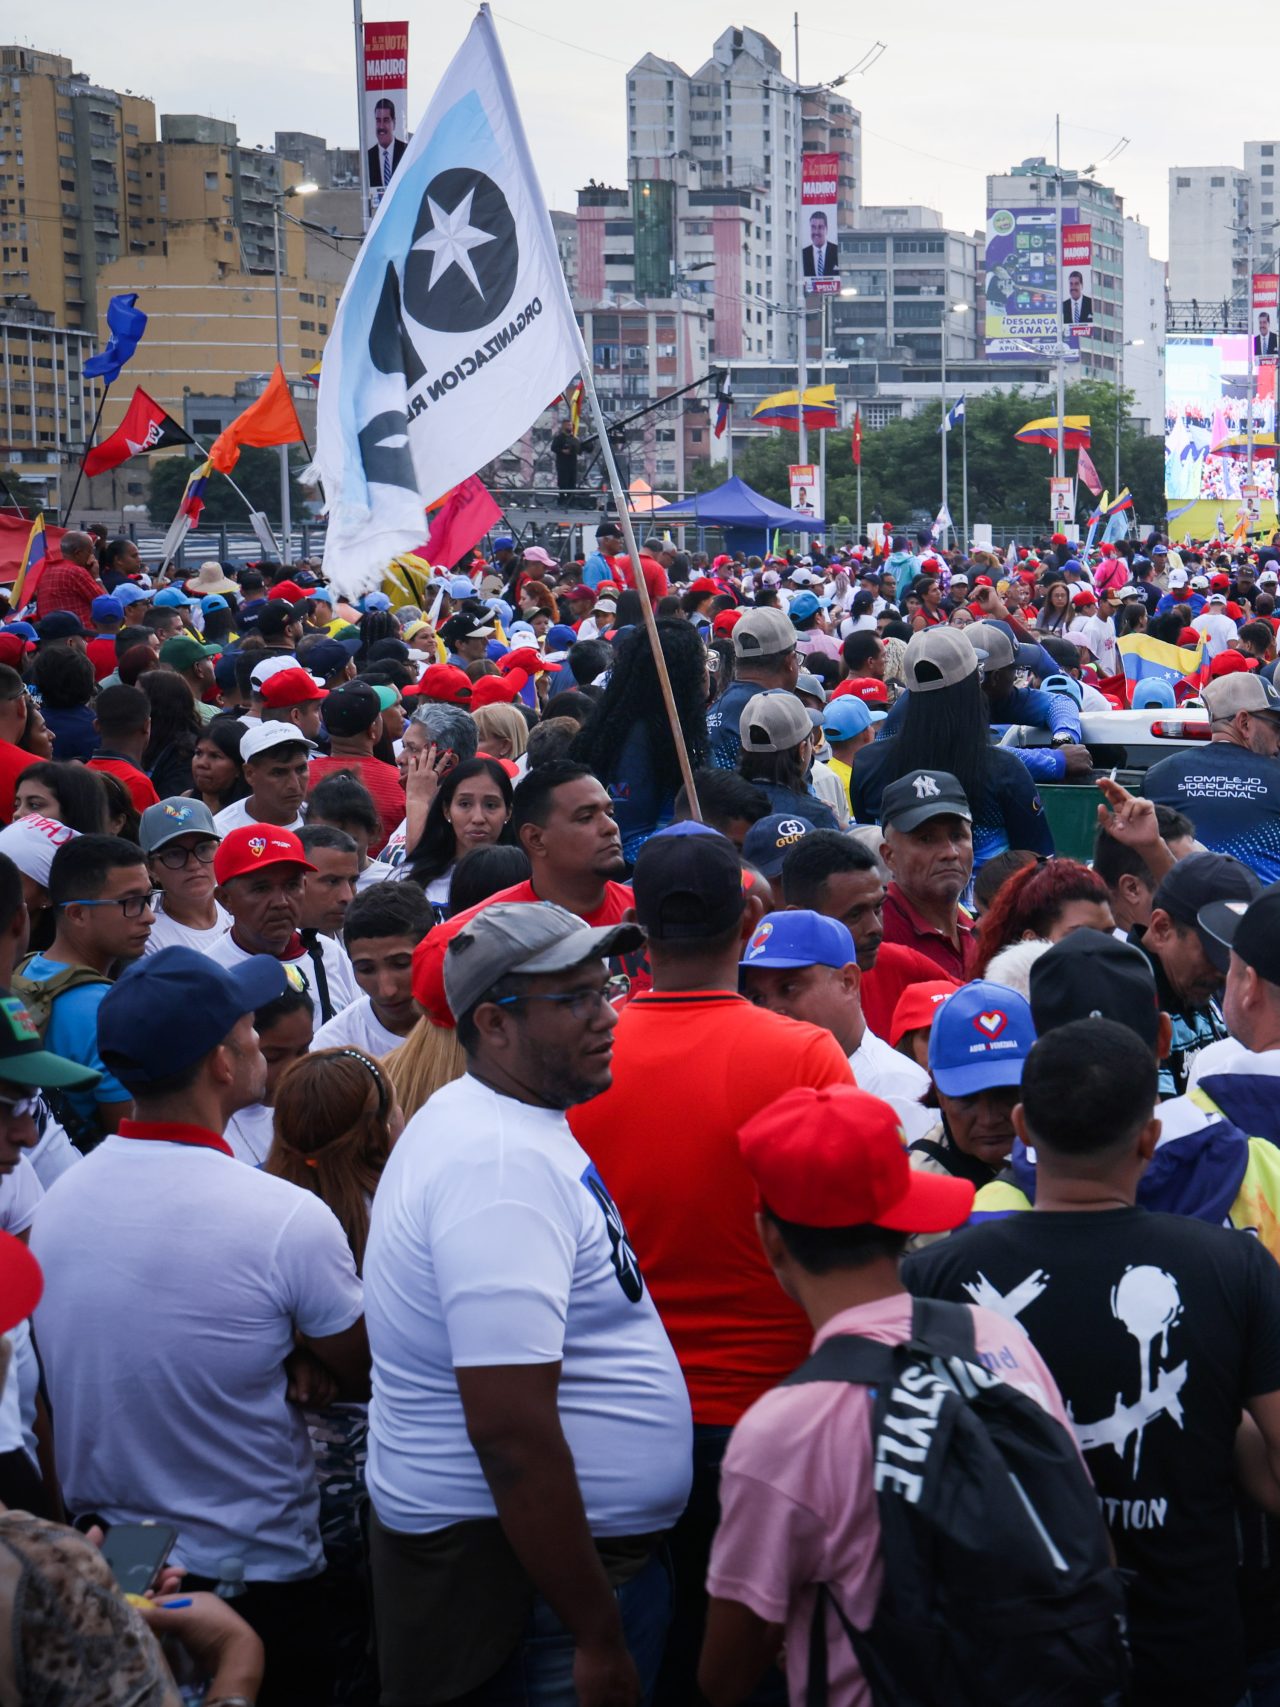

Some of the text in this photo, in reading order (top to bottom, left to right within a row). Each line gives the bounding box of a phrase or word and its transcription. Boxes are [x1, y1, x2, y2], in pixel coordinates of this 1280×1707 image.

[384, 35, 407, 50] VOTA
[366, 58, 406, 76] MADURO
[803, 180, 836, 195] MADURO
[1009, 326, 1042, 334] GANA
[1184, 775, 1261, 785] COMPLEJO
[1187, 790, 1256, 800] NACIONAL
[874, 1365, 951, 1503] STYLE
